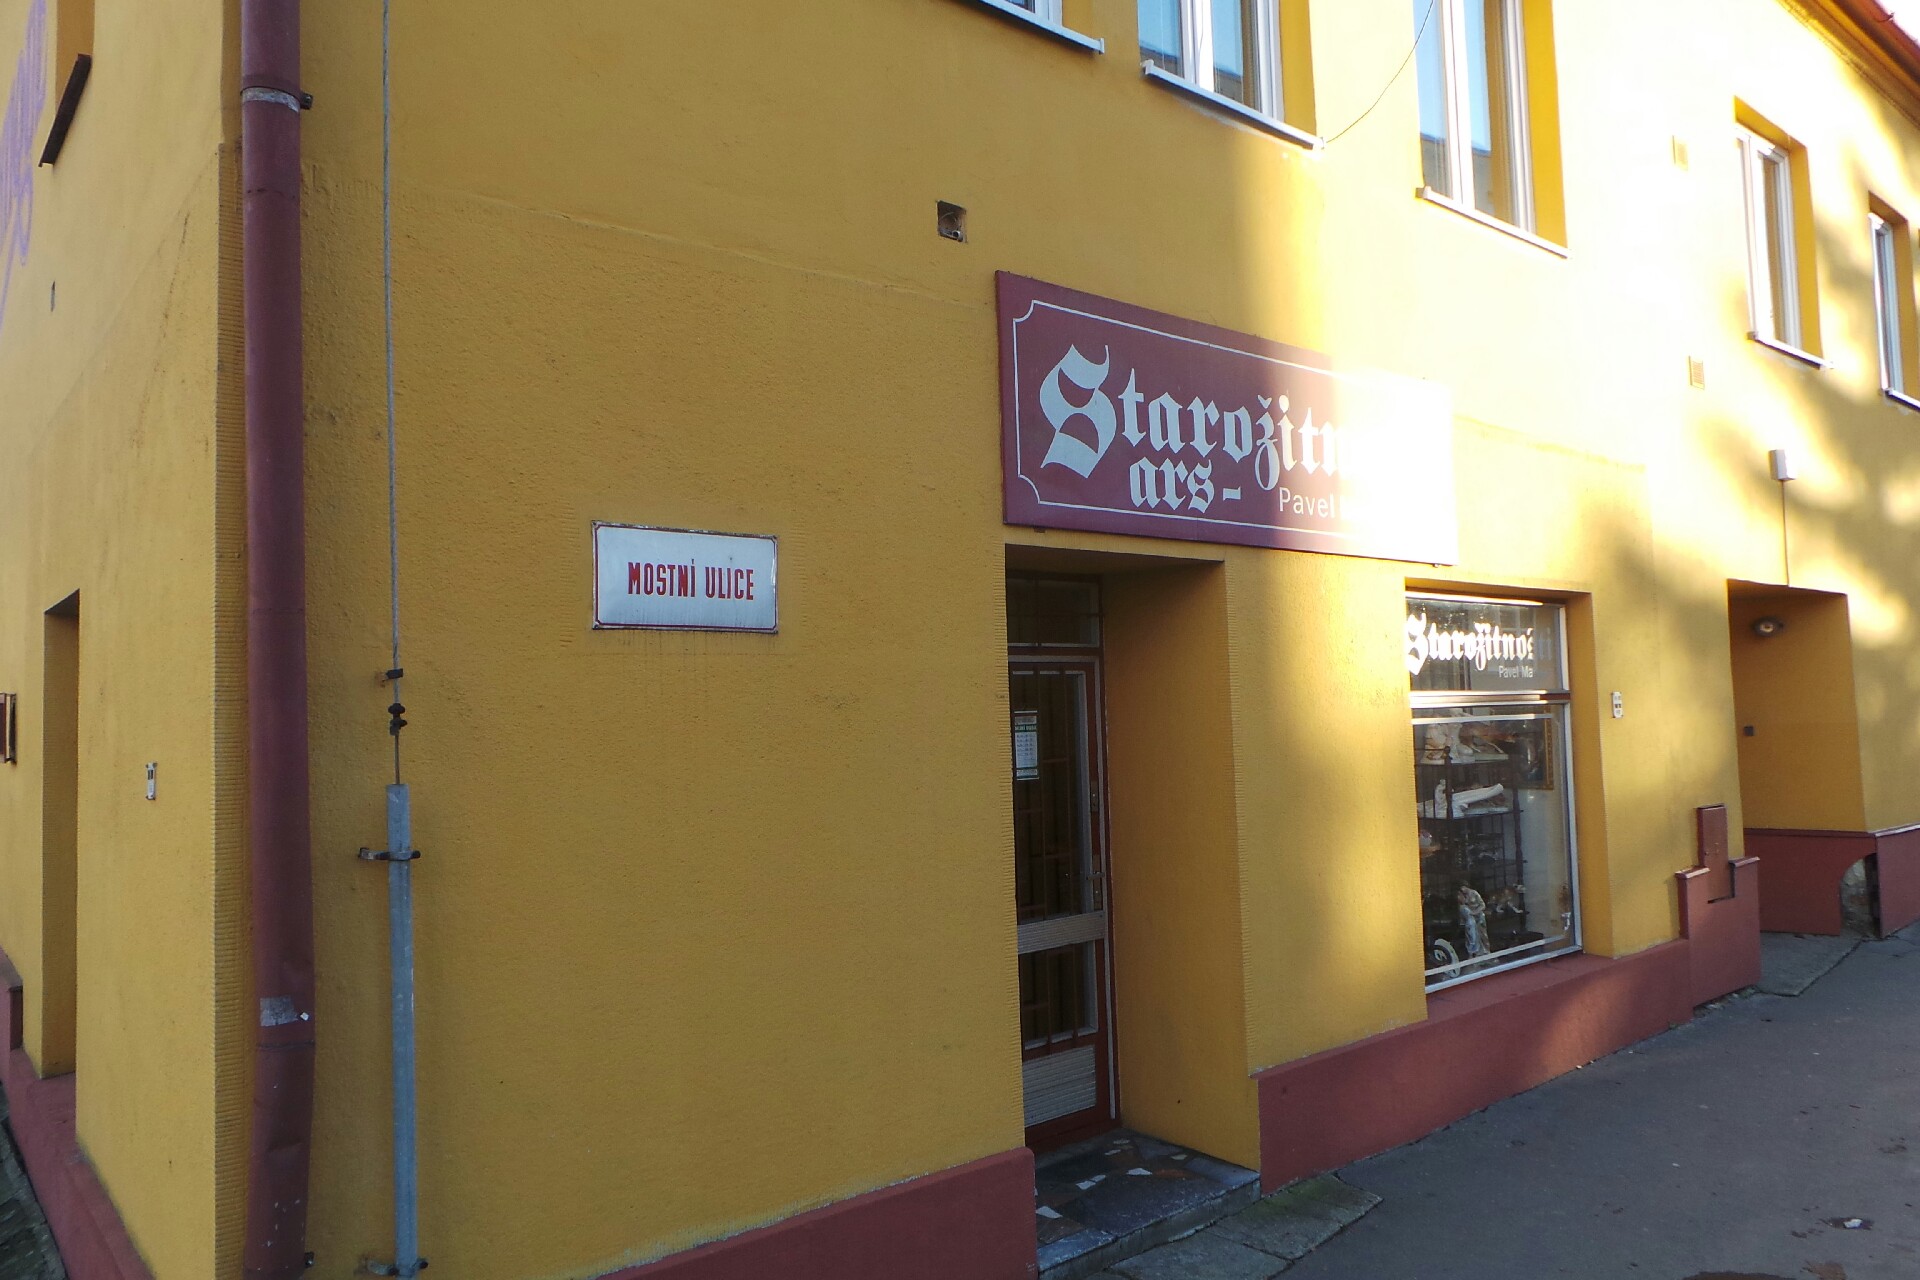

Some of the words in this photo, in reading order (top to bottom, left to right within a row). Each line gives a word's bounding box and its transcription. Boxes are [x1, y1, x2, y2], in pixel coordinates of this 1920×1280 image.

[1039, 343, 1350, 490] Starožitn
[1278, 487, 1336, 519] Pavel
[627, 558, 697, 598] MOSTNÍ
[704, 566, 755, 601] ULICE
[1498, 665, 1520, 678] Pavel
